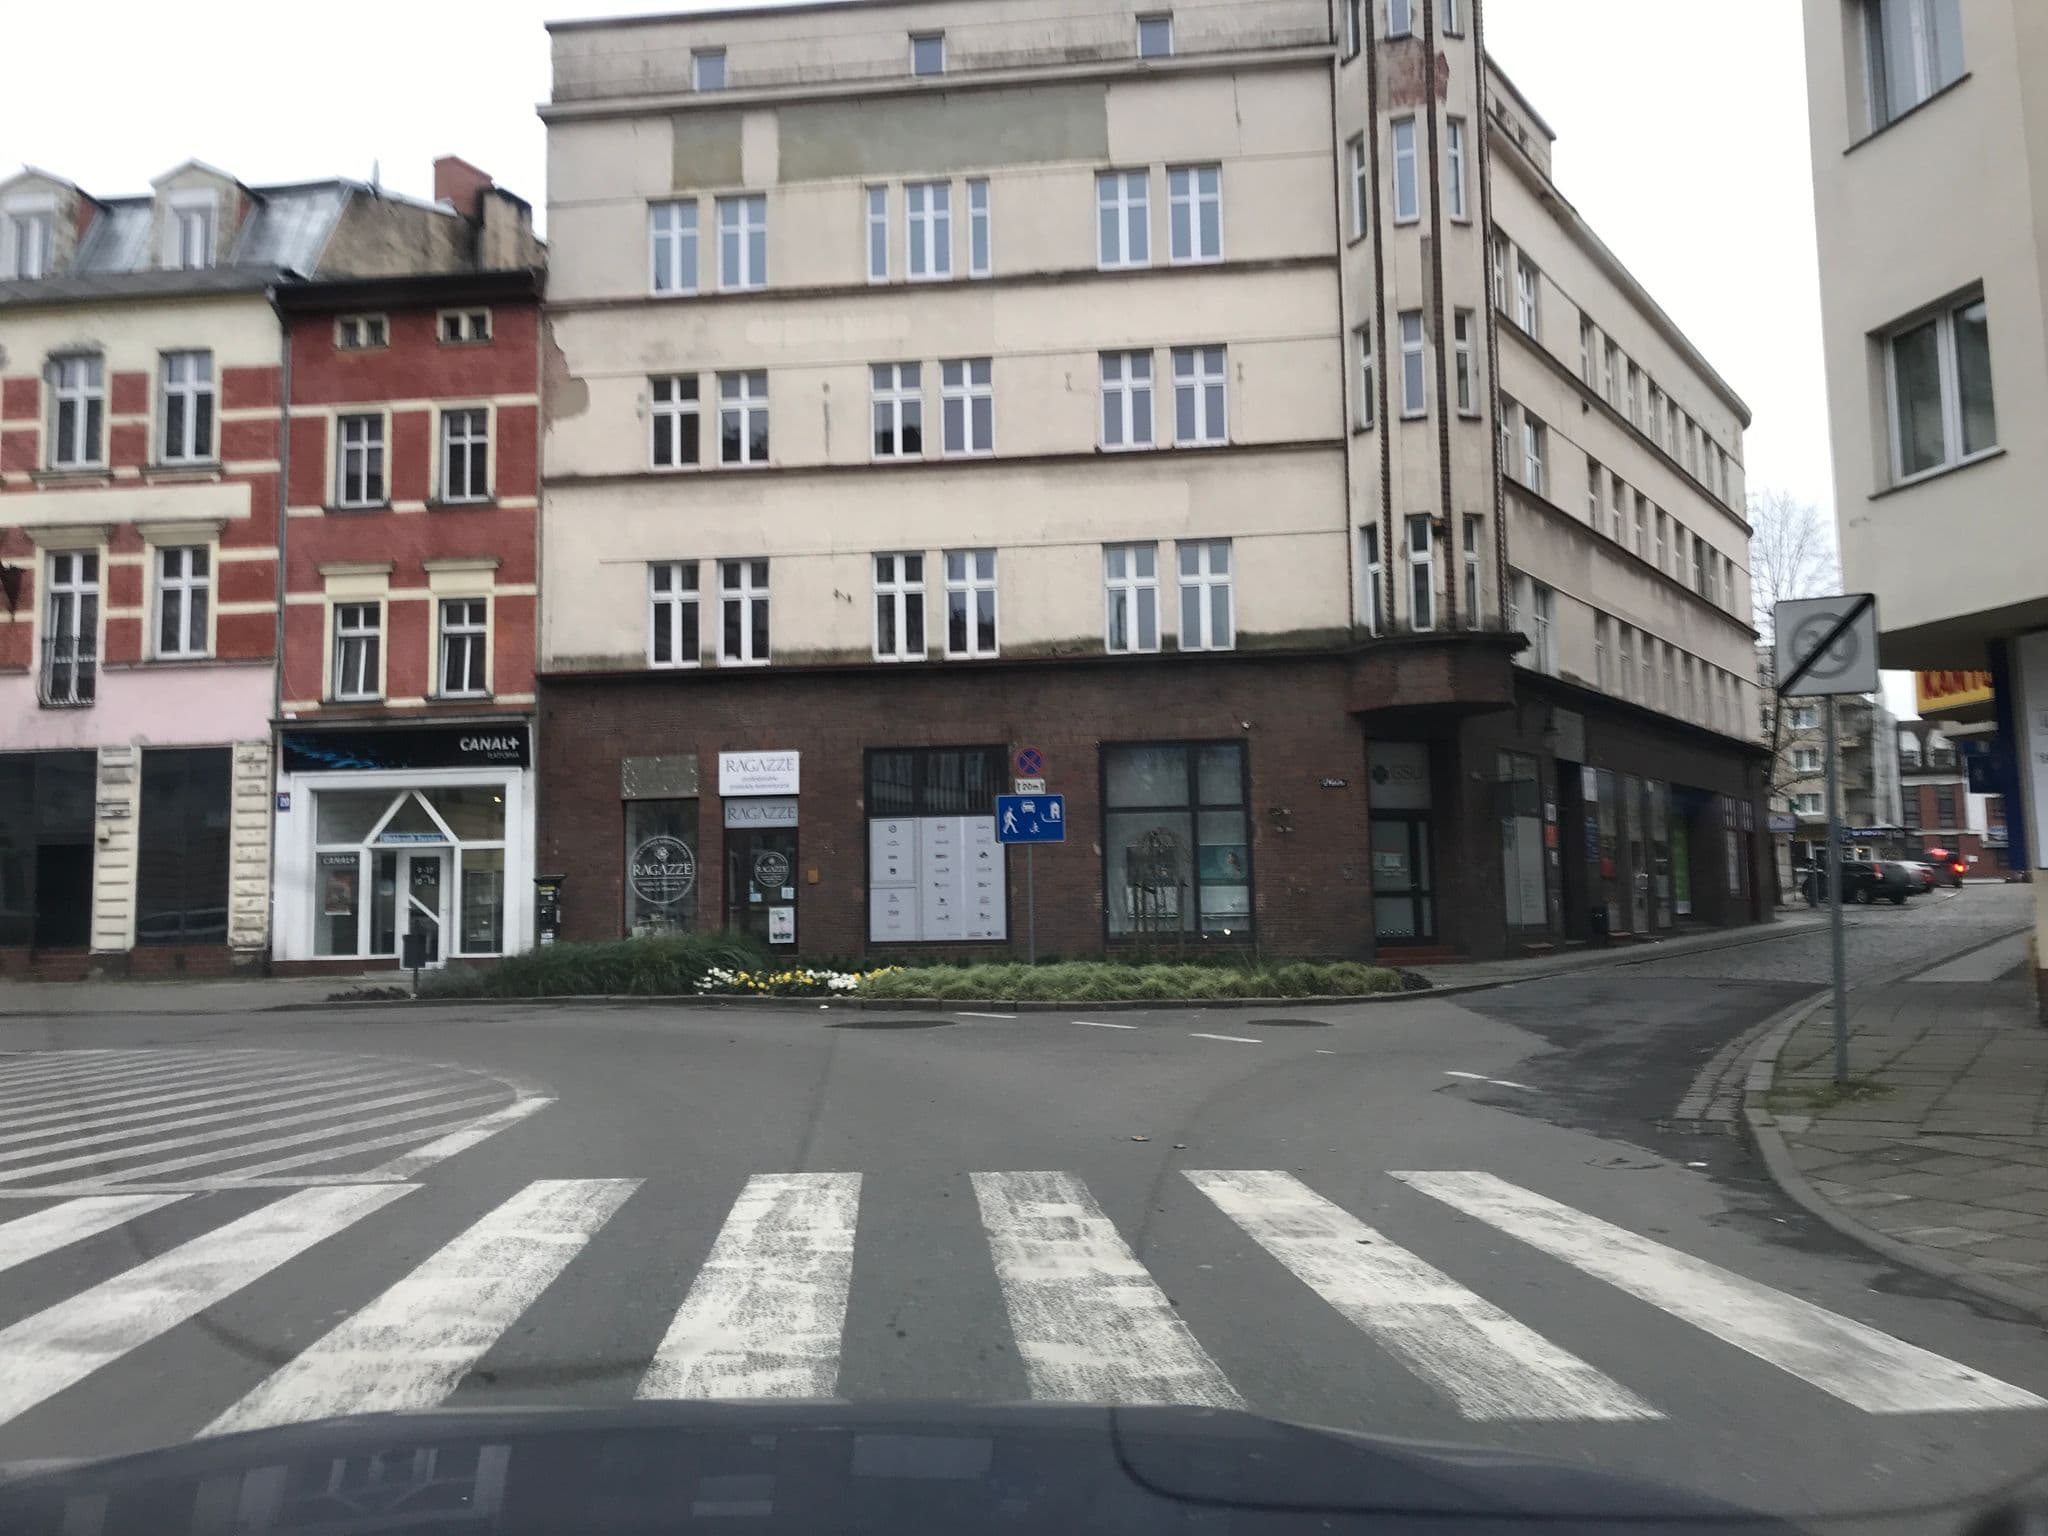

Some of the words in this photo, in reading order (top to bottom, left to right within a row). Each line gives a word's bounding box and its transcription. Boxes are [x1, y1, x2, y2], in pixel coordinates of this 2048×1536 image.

[460, 736, 520, 751] CANAL+
[726, 758, 795, 773] RAGAZZE
[728, 807, 797, 820] RAGAZZE
[632, 862, 692, 876] RAGAZZE
